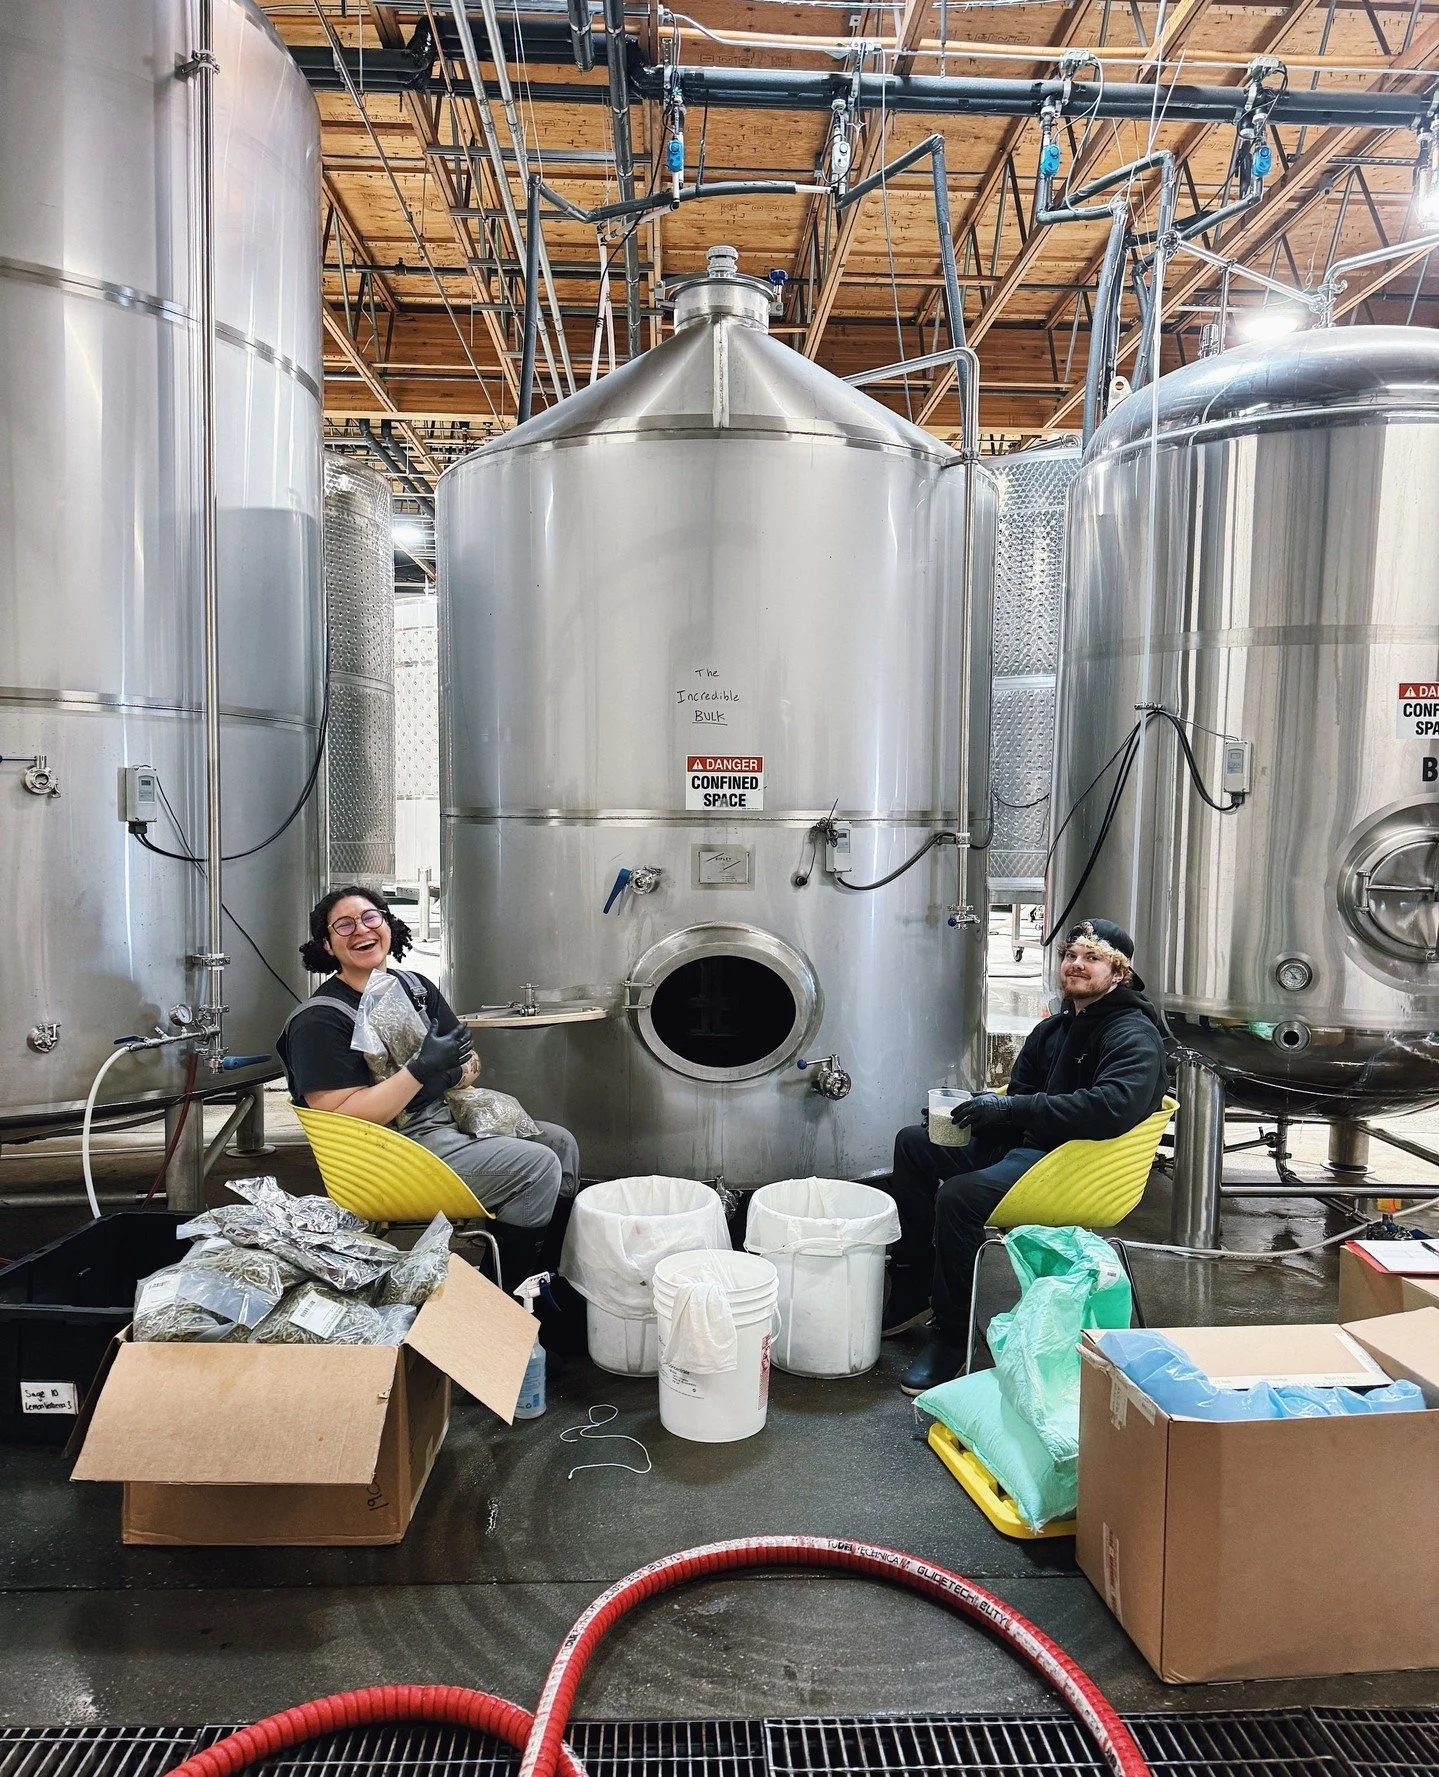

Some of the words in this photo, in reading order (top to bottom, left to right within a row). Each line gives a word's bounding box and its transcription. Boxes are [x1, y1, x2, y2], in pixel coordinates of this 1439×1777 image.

[695, 668, 719, 677] The
[677, 690, 739, 703] Incredible
[1420, 685, 1439, 698] DA
[695, 710, 725, 722] BULK
[706, 759, 758, 770] DANGER
[691, 775, 759, 790] CONFINED
[703, 793, 746, 807] SPACE
[25, 1390, 45, 1402] Sage
[979, 1600, 1013, 1631] BUTYL
